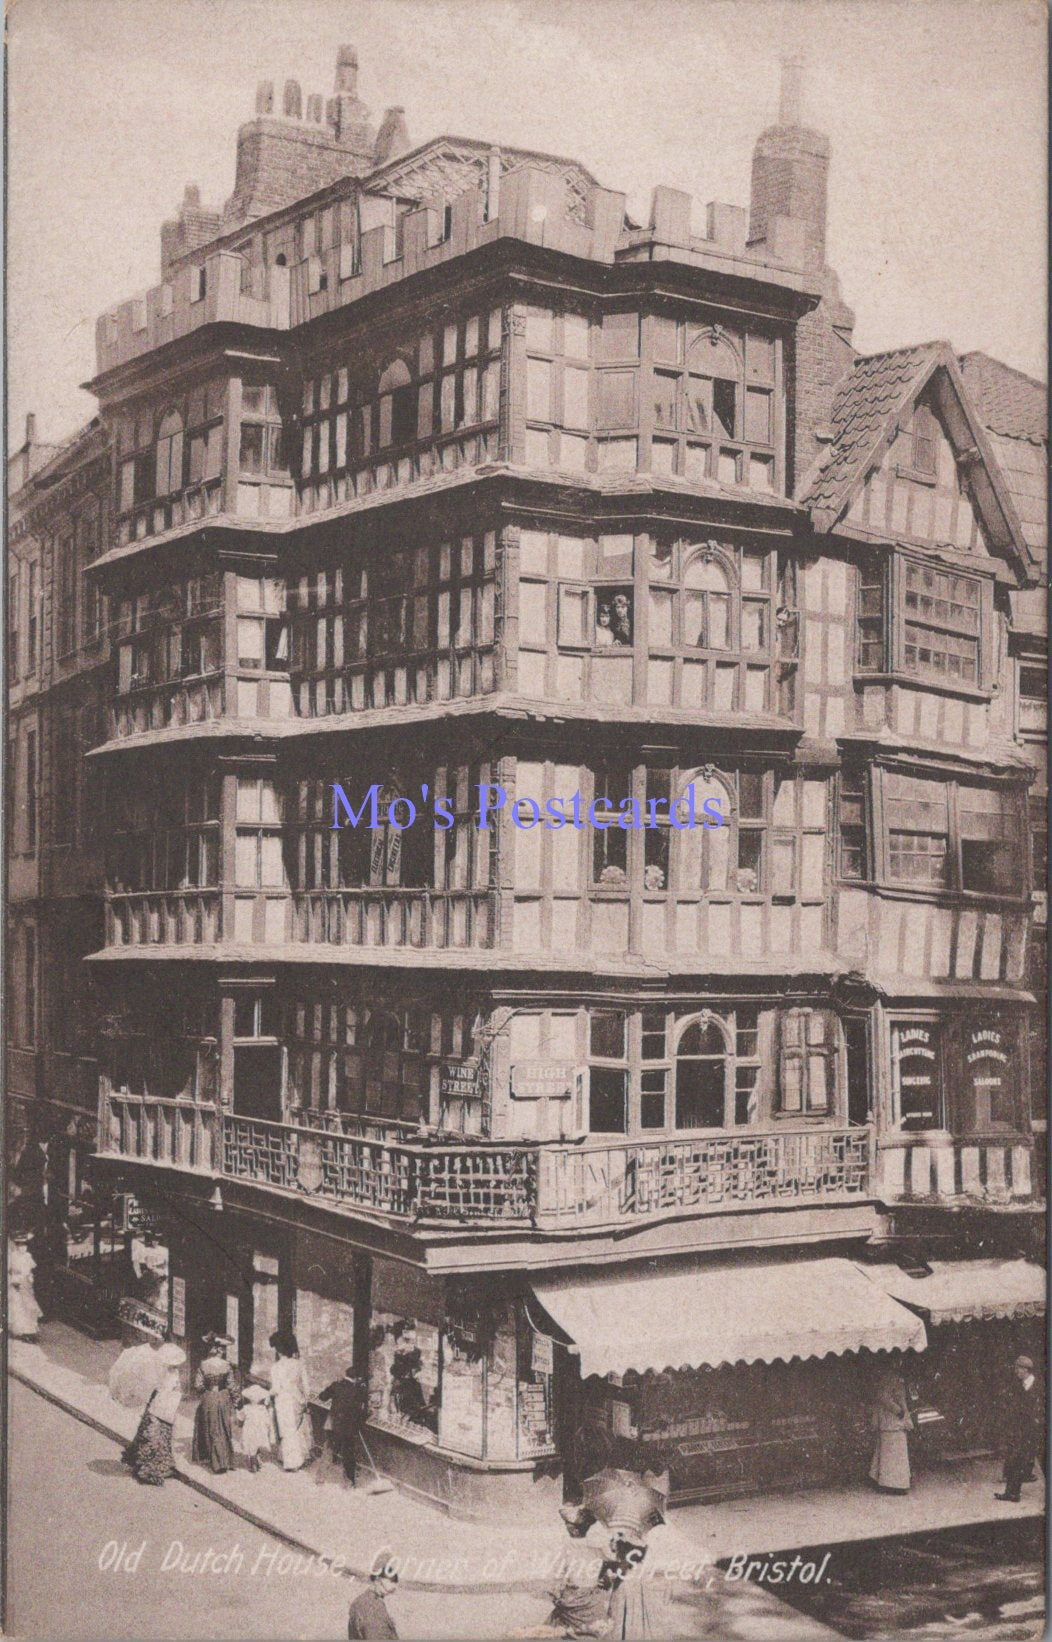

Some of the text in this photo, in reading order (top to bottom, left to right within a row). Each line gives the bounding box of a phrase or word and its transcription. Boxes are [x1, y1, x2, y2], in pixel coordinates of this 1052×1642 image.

[900, 1028, 930, 1043] LADIES
[972, 1030, 1001, 1044] LADIES
[447, 1066, 474, 1080] WINE
[526, 1067, 566, 1079] HIGH
[442, 1079, 481, 1095] STREET
